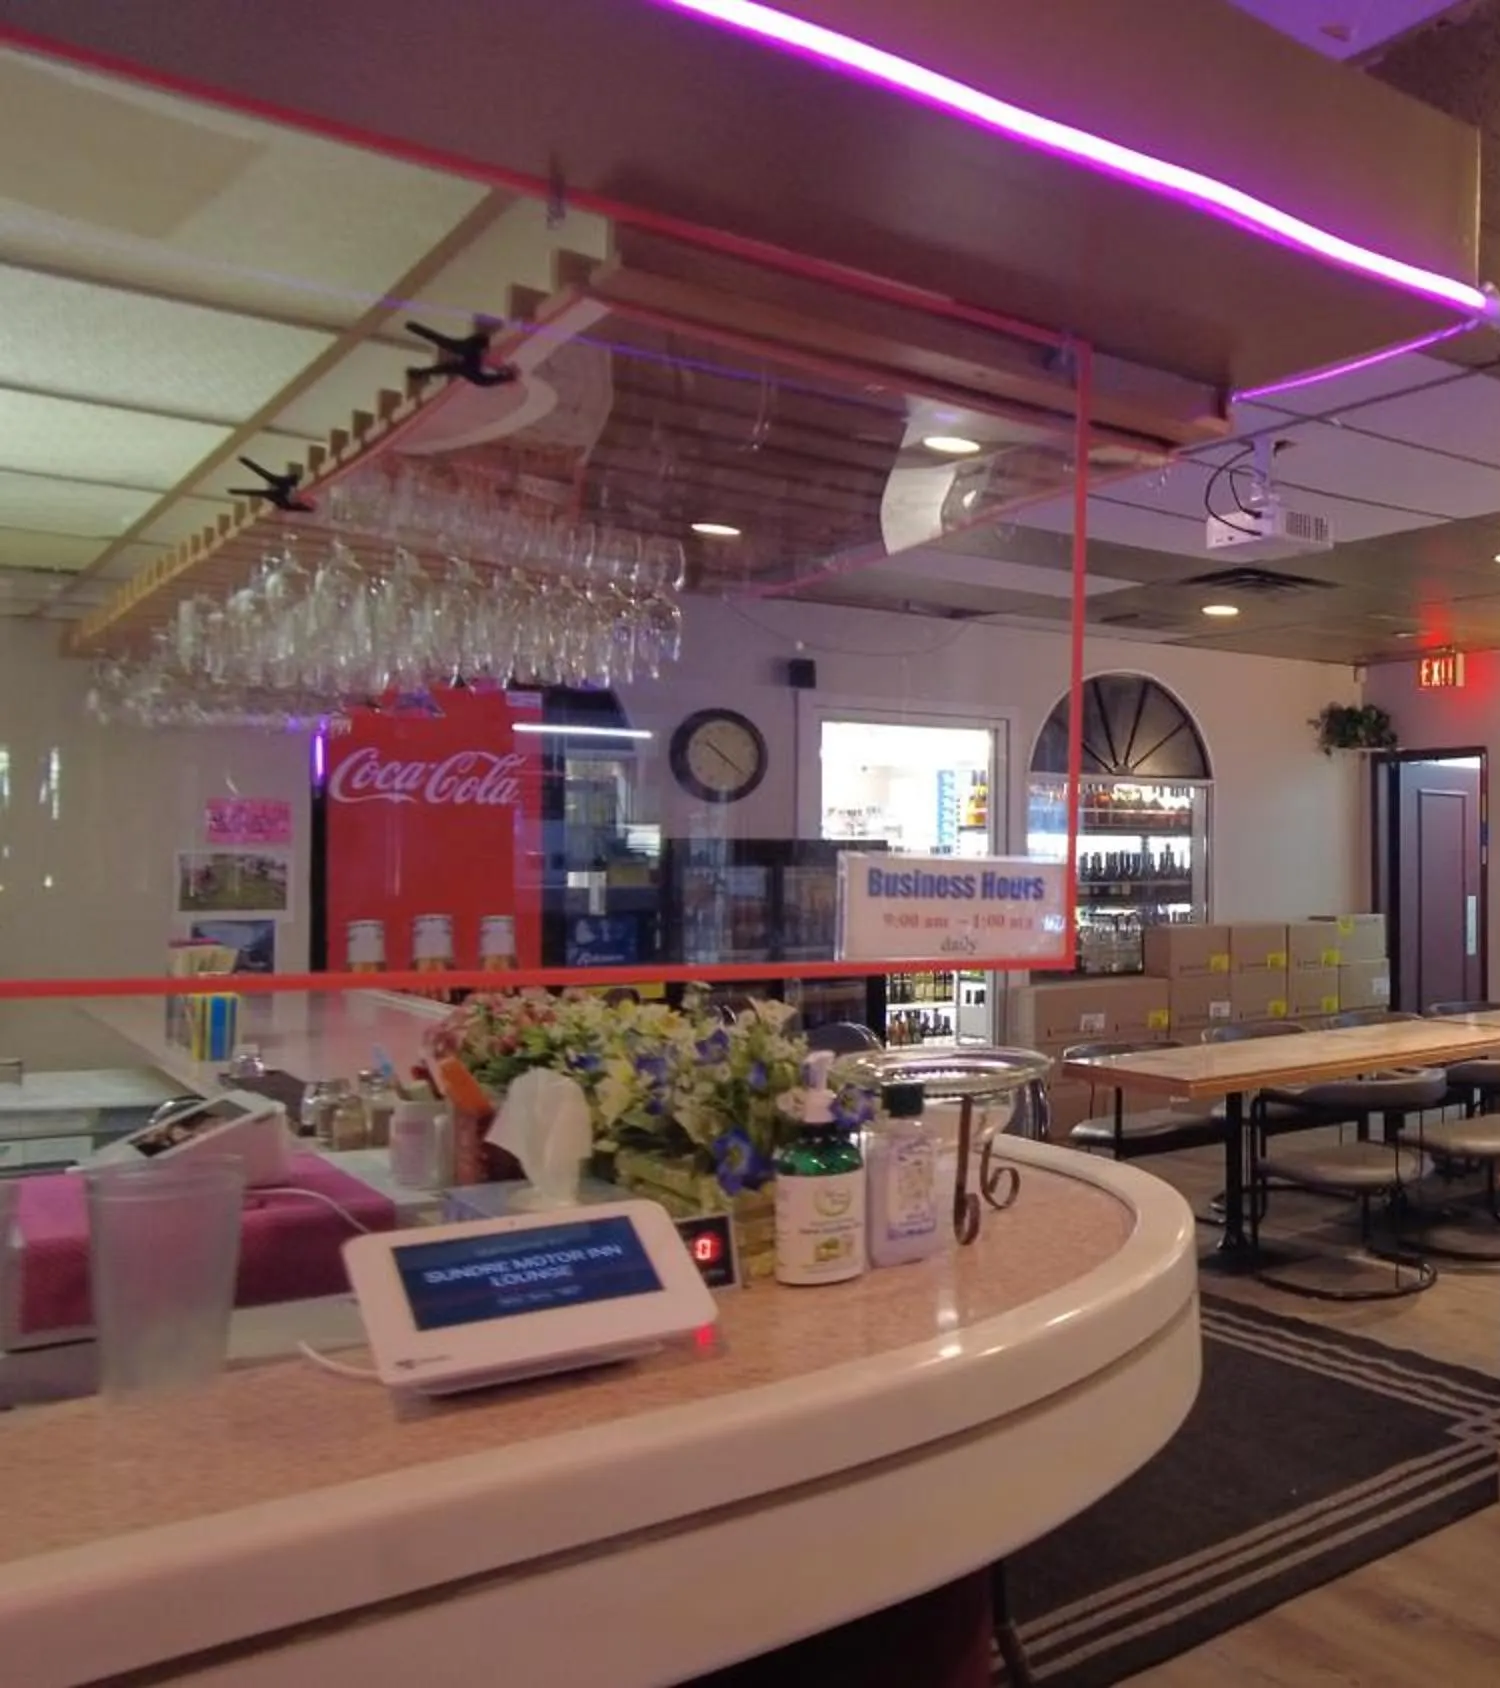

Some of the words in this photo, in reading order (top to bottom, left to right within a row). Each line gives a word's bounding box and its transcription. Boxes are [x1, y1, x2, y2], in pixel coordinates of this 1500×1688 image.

[1421, 658, 1453, 687] EXIT
[329, 747, 526, 804] Coca-Cola
[868, 867, 976, 898] Business
[981, 871, 1045, 901] Hours
[512, 1246, 587, 1271] MOTOR
[490, 1264, 575, 1289] LOUNGE
